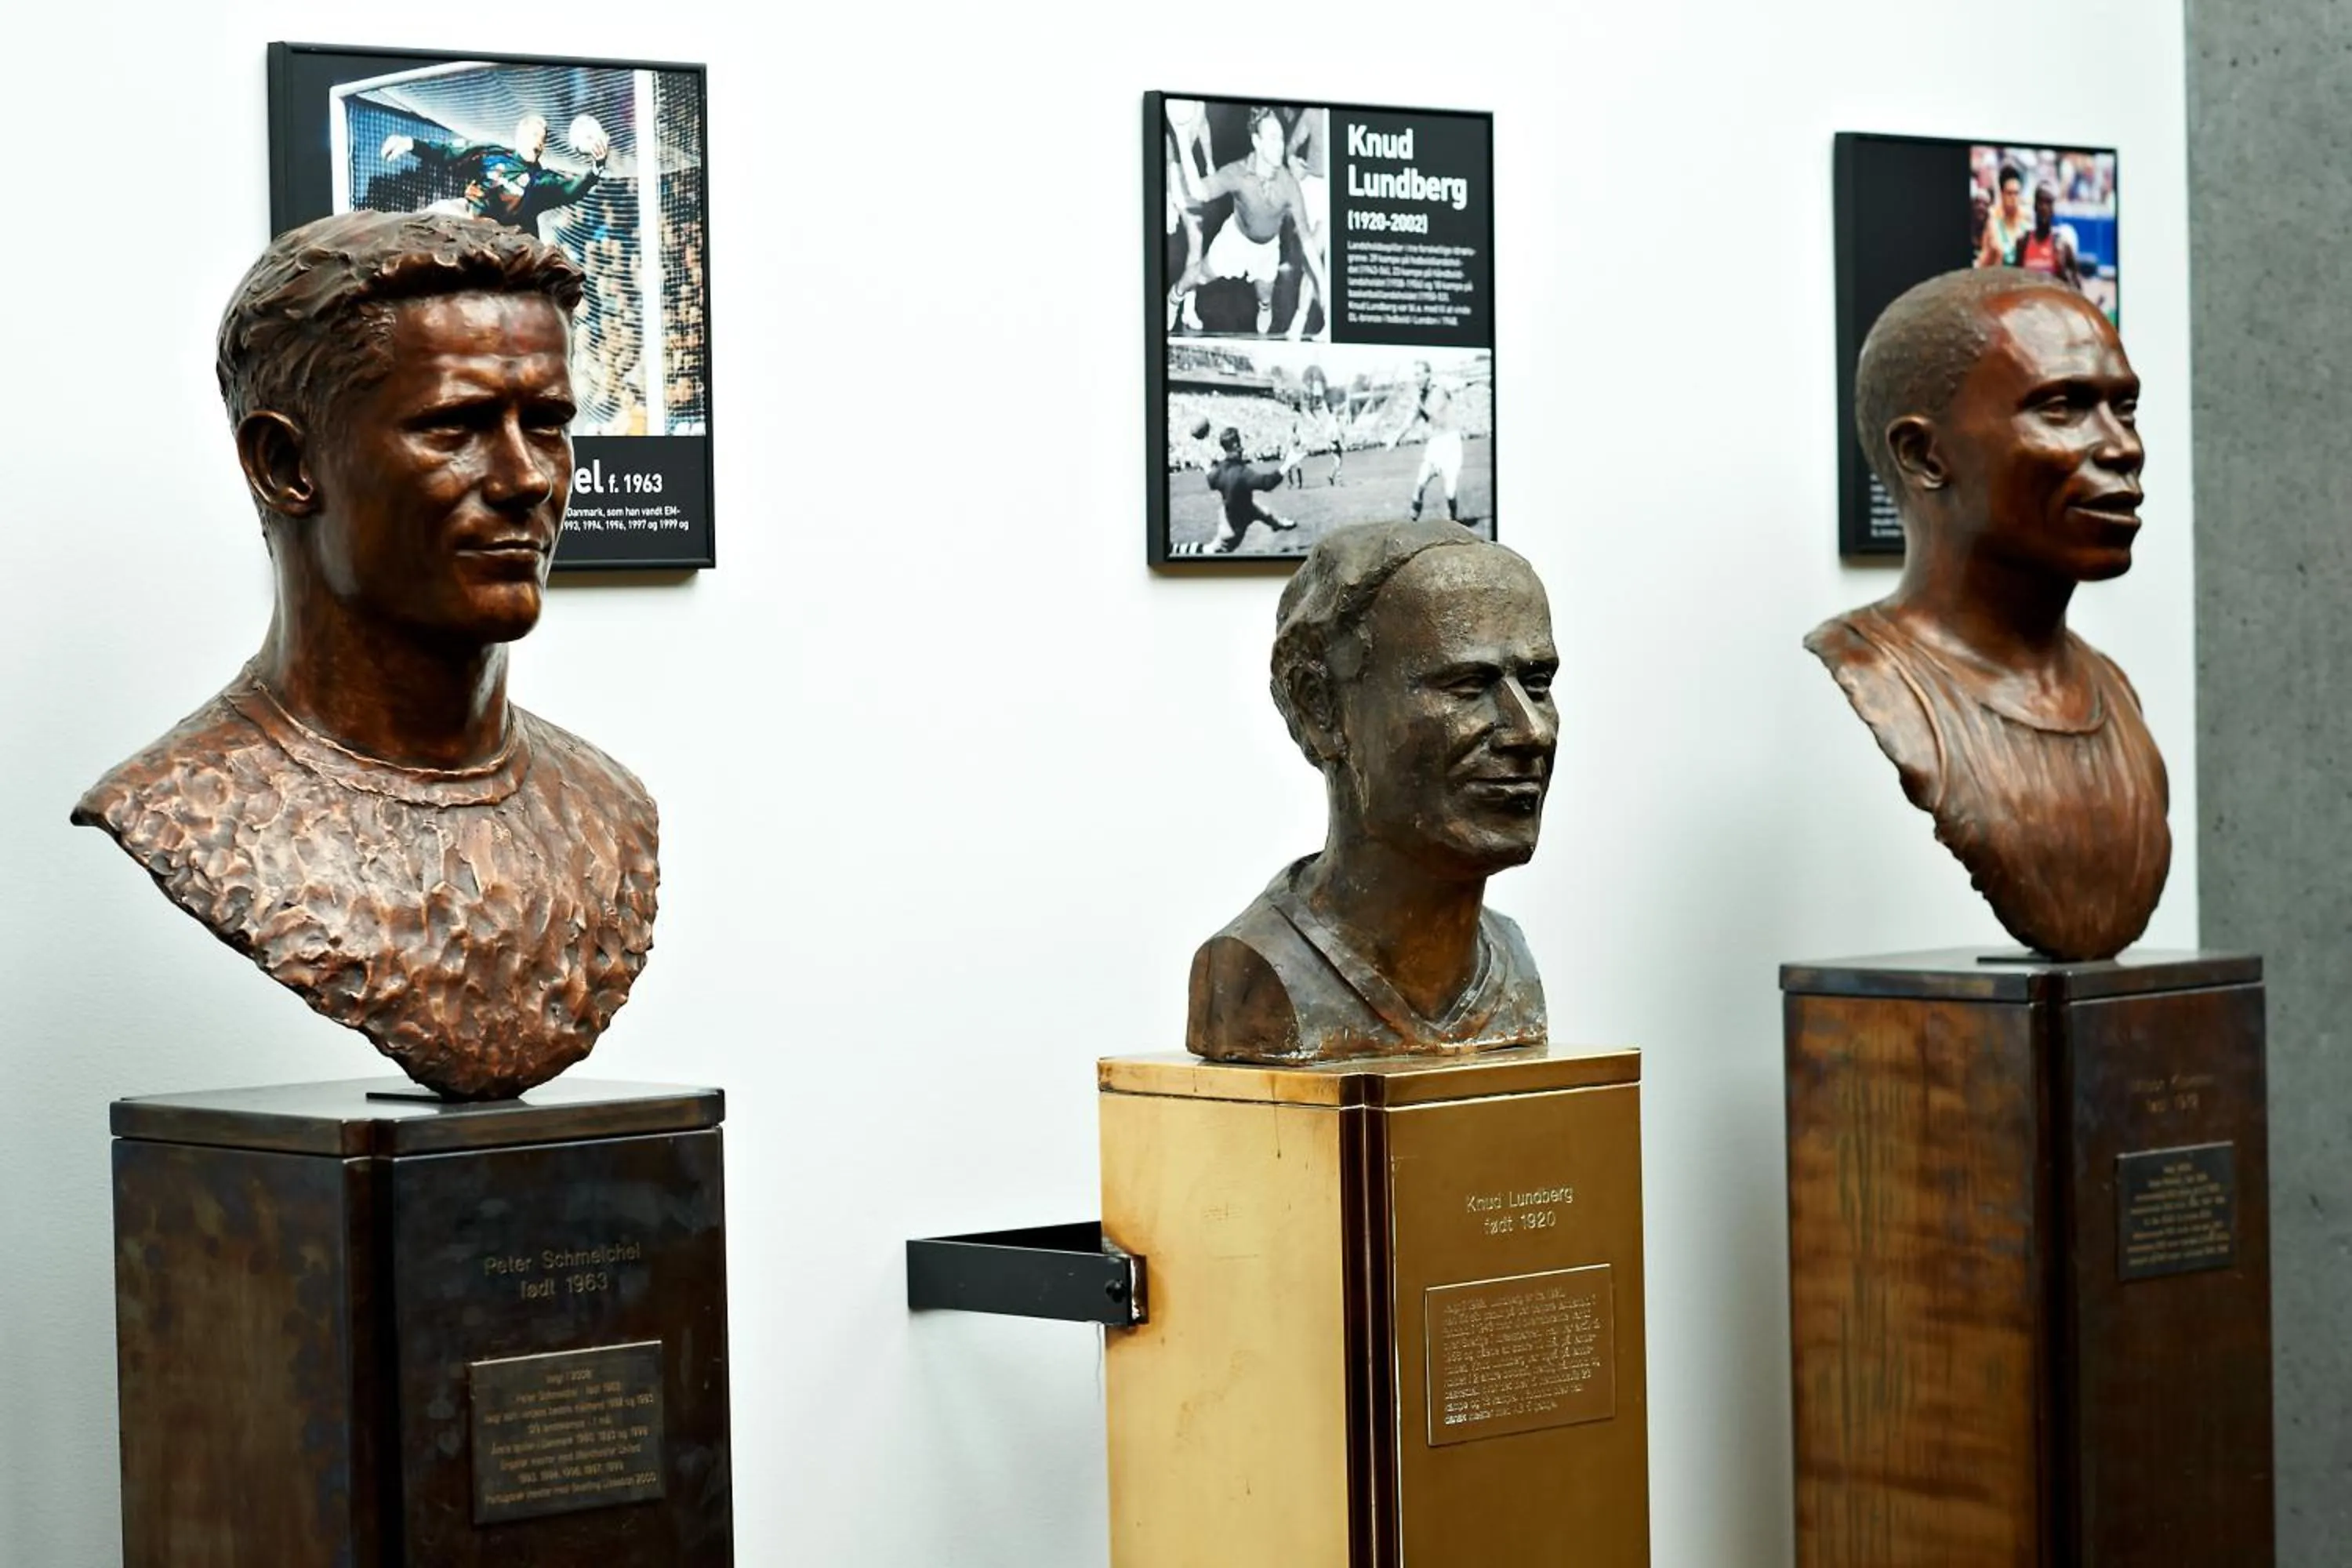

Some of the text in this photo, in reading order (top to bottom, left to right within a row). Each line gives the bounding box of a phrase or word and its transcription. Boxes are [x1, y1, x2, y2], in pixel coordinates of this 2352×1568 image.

[1348, 124, 1414, 160] Knud
[1348, 164, 1467, 210] Lundberg
[572, 459, 663, 494] el f. 1963
[567, 507, 605, 517] Danmark,
[625, 506, 640, 517] han
[641, 506, 662, 516] vandt
[562, 521, 581, 531] 993,
[628, 519, 647, 529] 1997
[648, 521, 658, 531] og
[679, 521, 689, 531] og
[1467, 1187, 1573, 1213] Knud Lundberg
[1520, 1210, 1556, 1229] 1920
[485, 1242, 641, 1276] Peter Schmeichel
[566, 1272, 608, 1294] 1963
